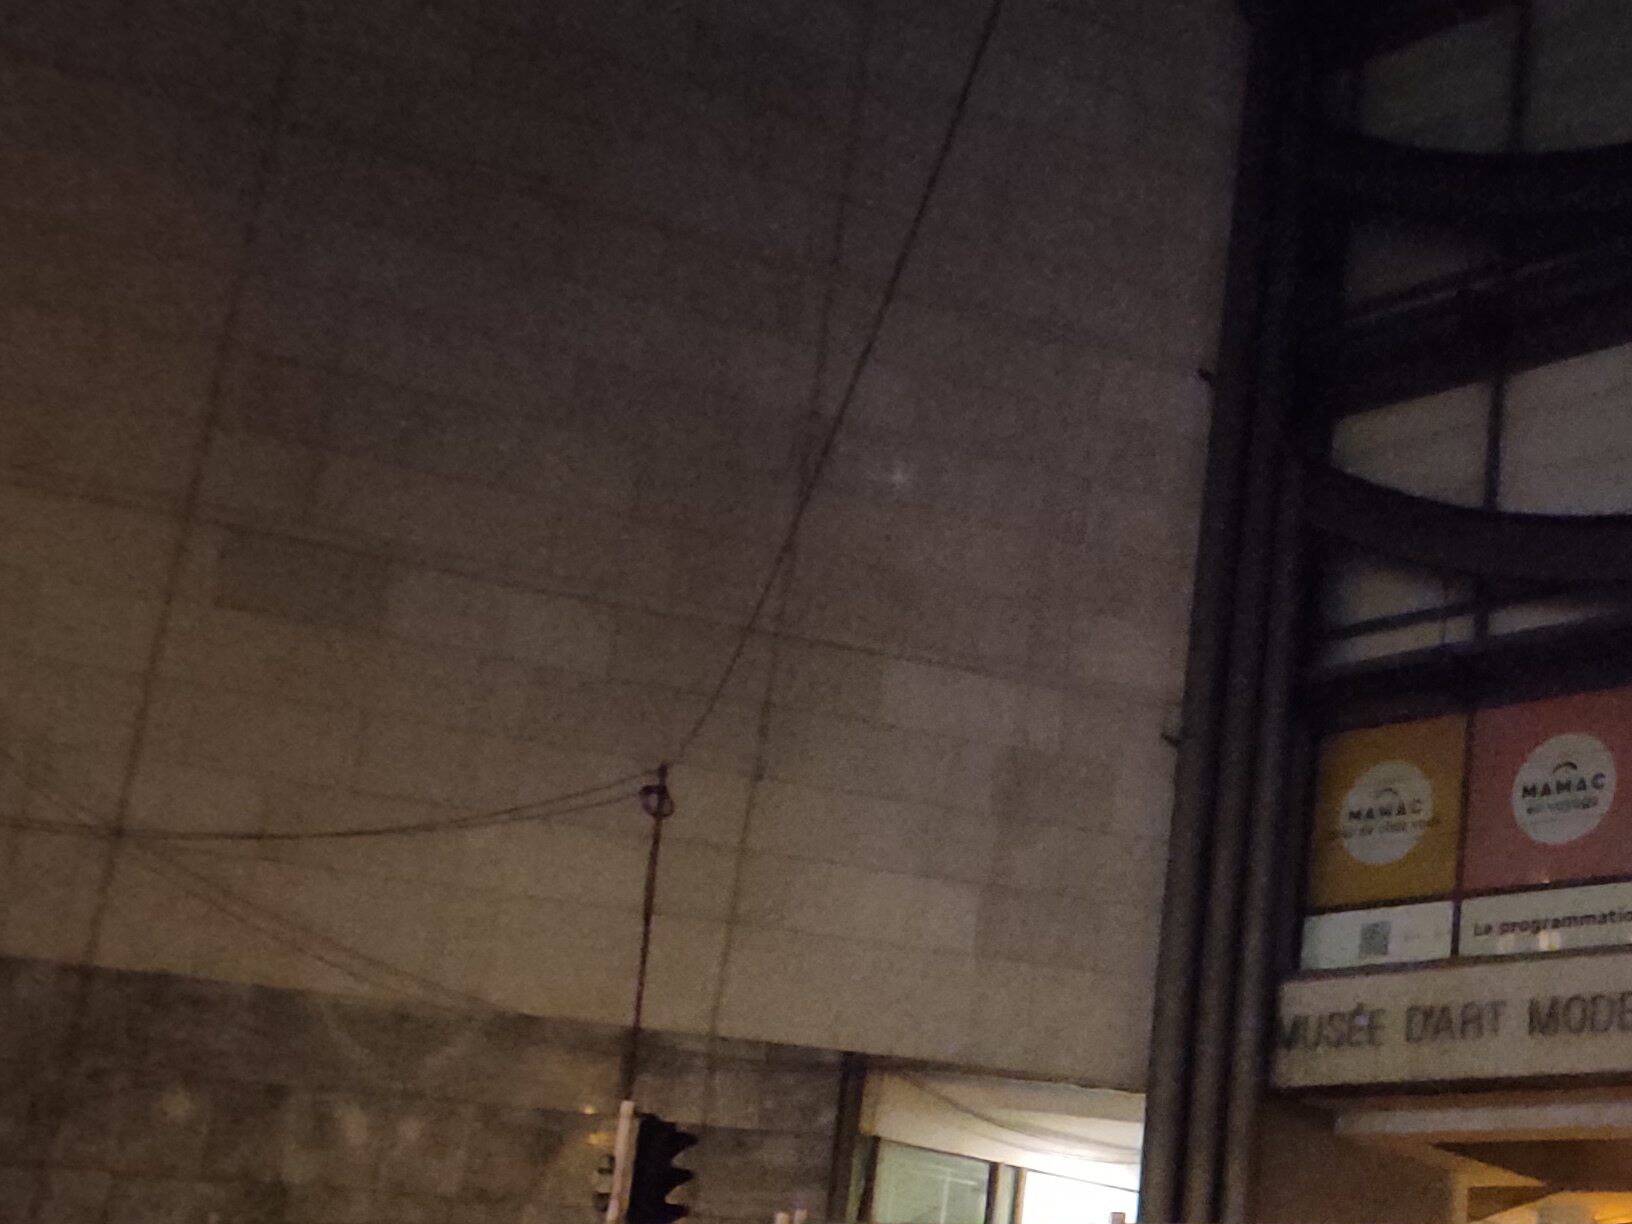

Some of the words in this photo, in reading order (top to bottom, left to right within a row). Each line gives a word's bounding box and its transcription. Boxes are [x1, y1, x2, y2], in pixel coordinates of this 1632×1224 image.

[1522, 772, 1606, 798] MAMAC
[1349, 799, 1422, 820] MAMAC
[1278, 1003, 1386, 1051] MUSÉE
[1405, 999, 1507, 1044] D'ART
